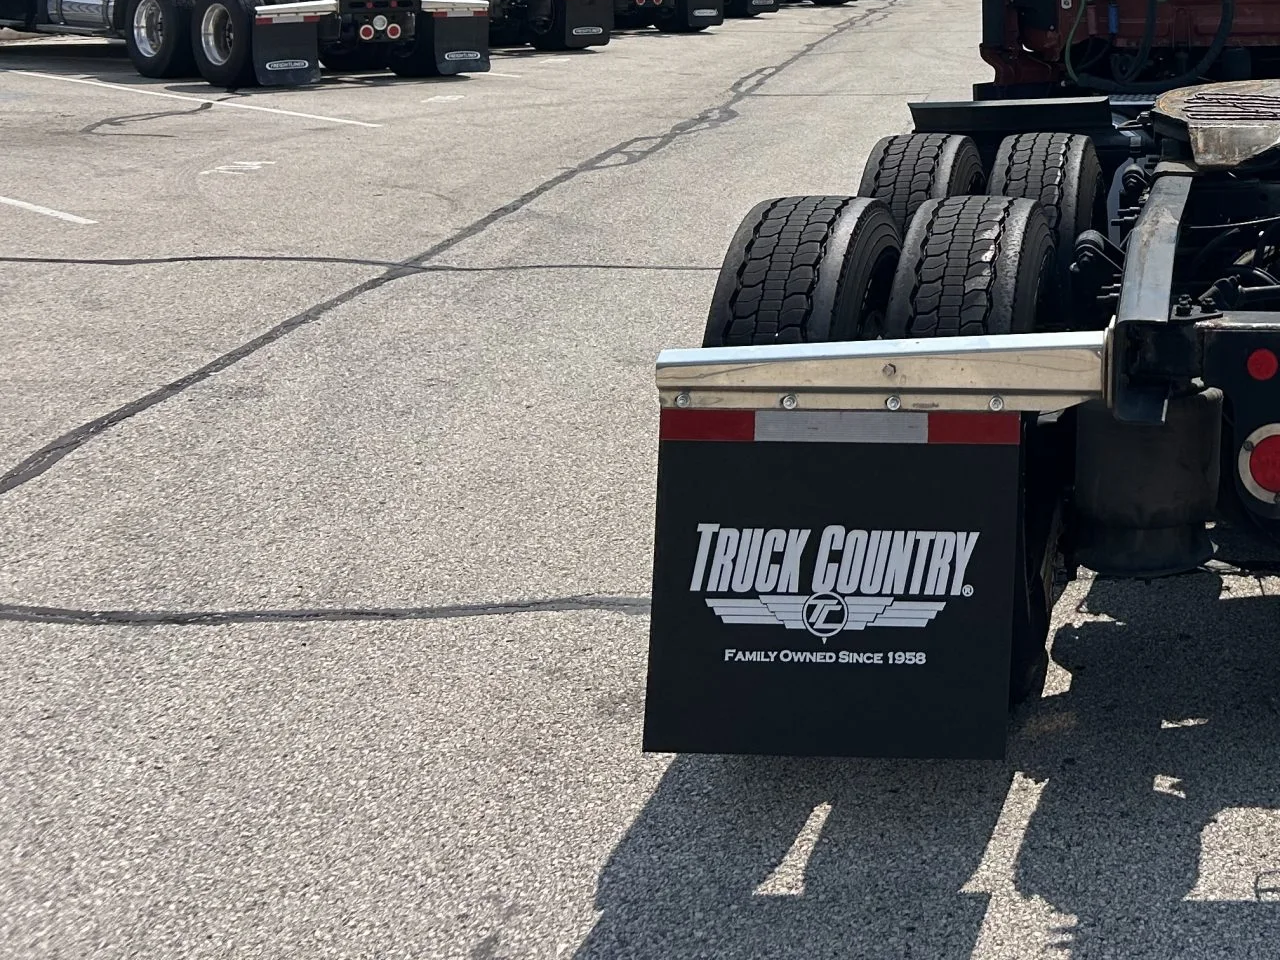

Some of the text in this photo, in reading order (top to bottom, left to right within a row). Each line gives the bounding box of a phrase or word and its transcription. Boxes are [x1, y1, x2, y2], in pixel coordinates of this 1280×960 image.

[689, 523, 811, 593] TRUCK
[725, 648, 926, 665] FAMILY OWNED SINCE 1958
